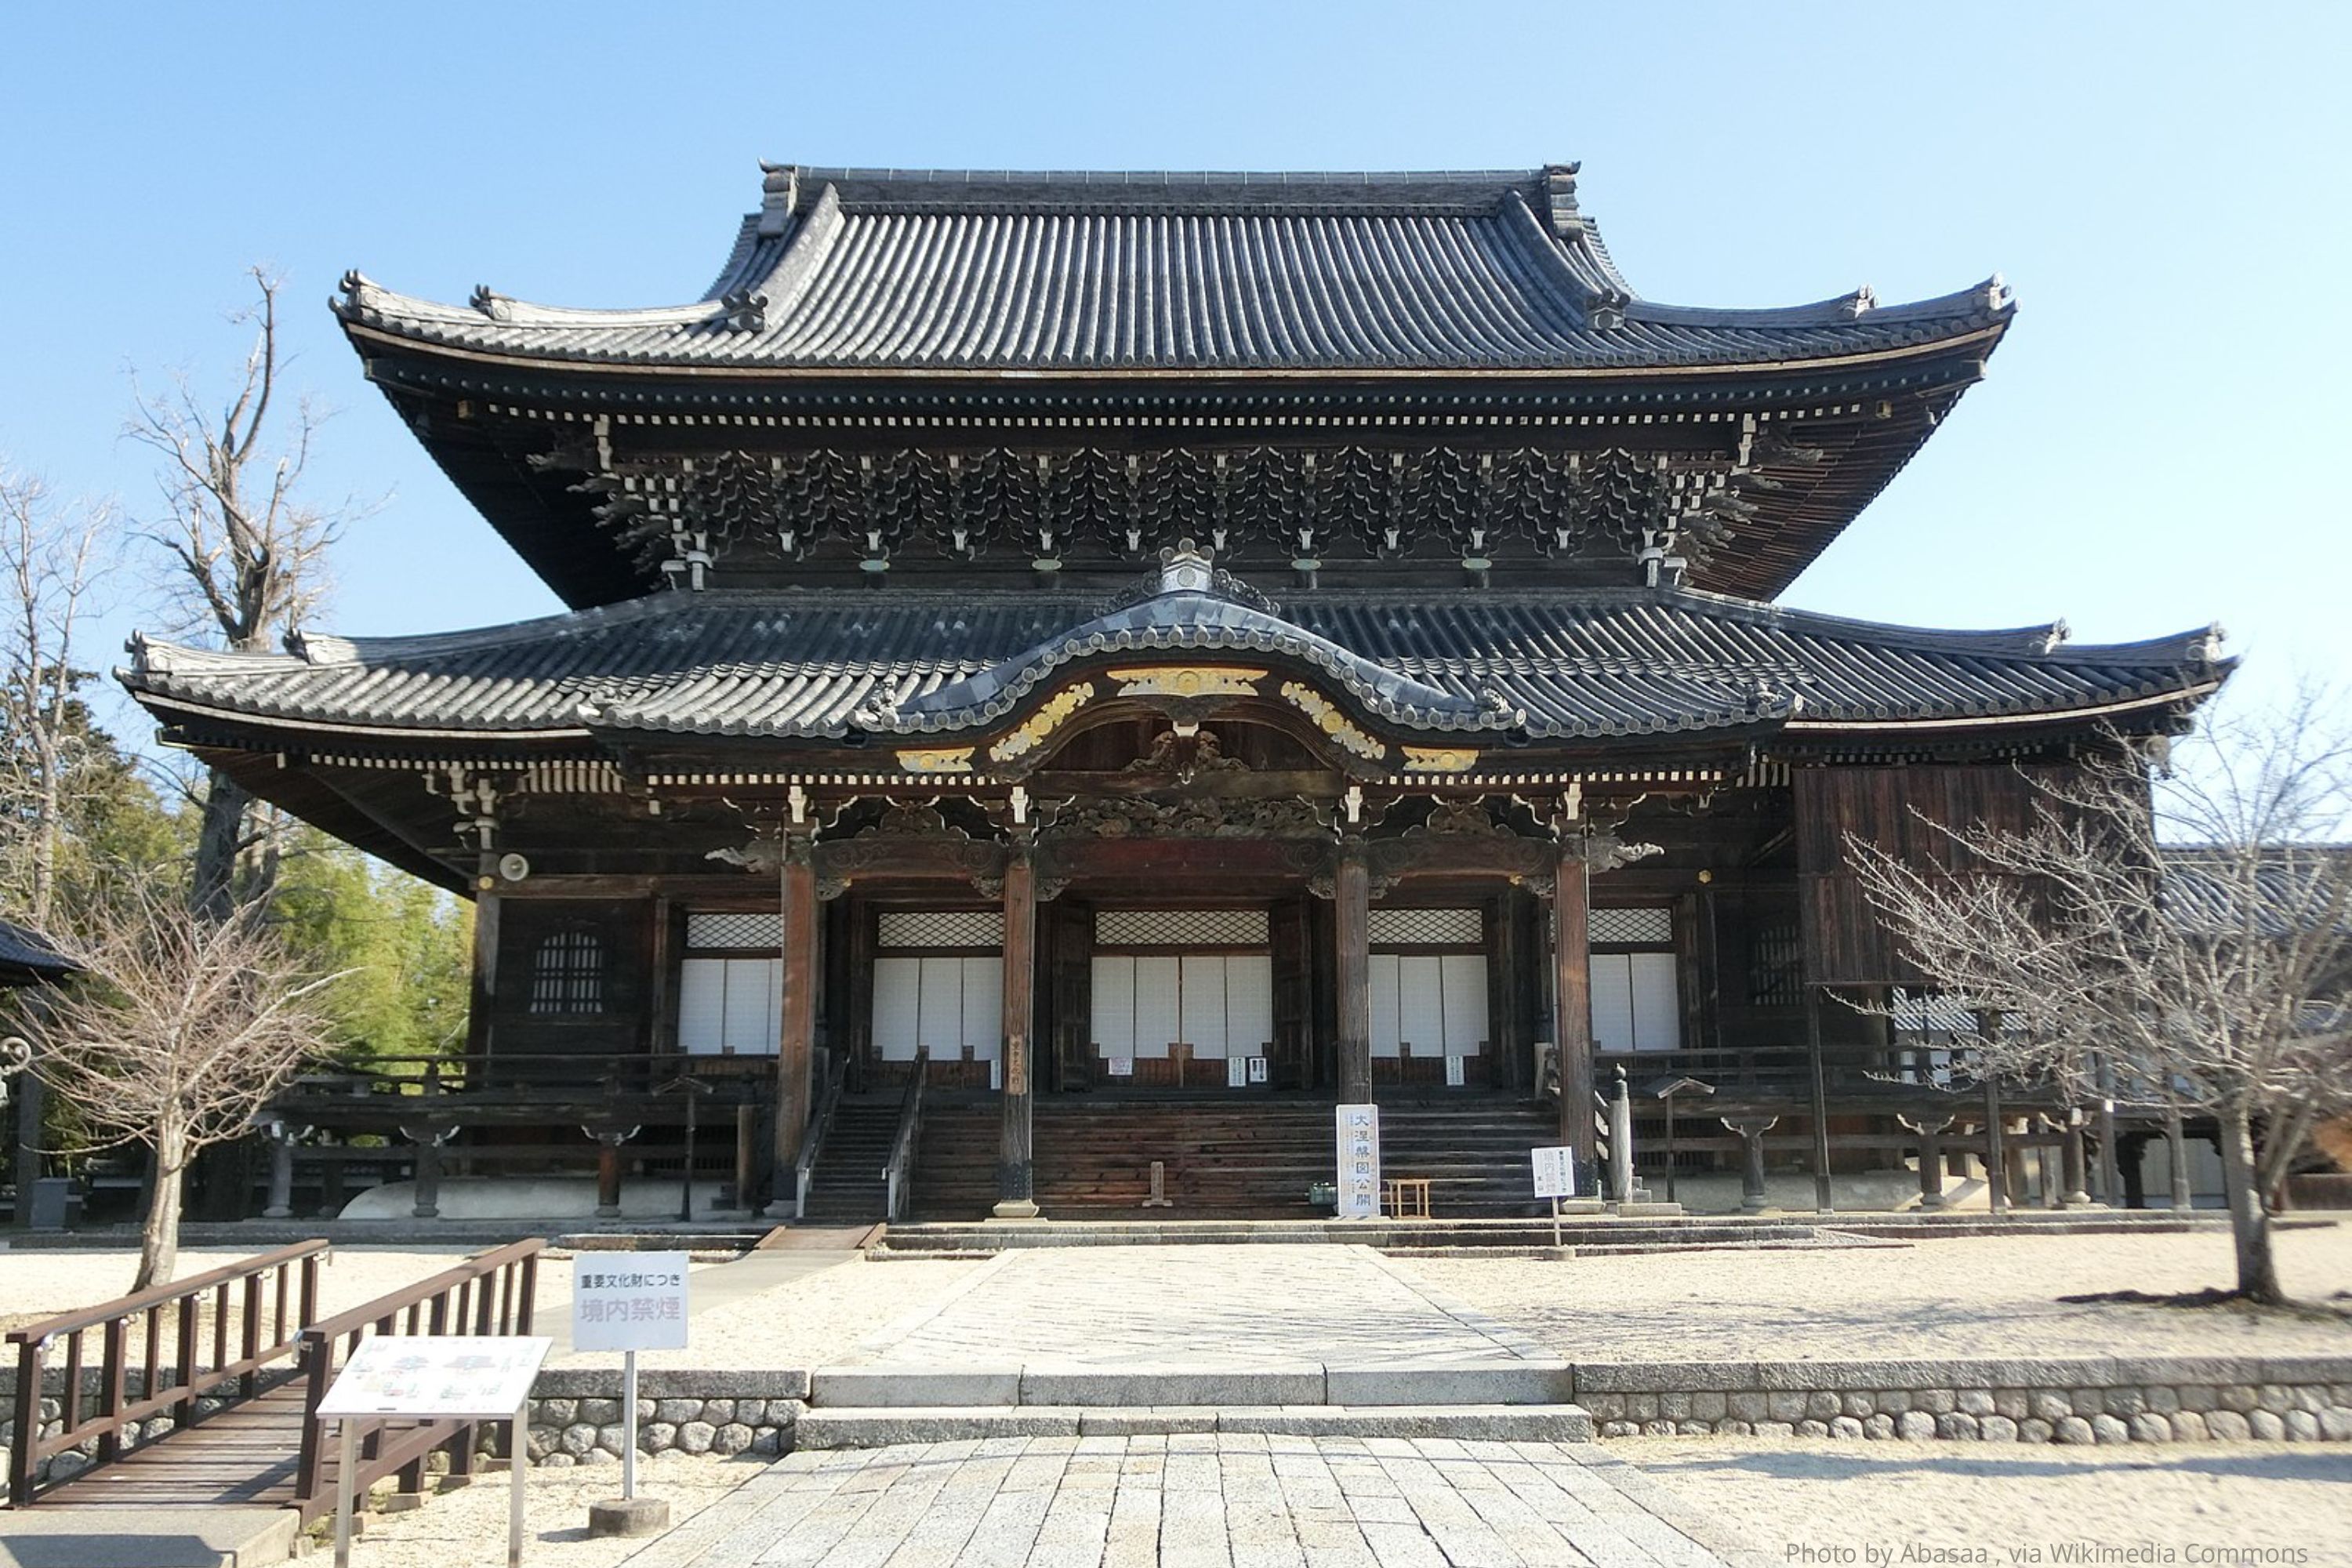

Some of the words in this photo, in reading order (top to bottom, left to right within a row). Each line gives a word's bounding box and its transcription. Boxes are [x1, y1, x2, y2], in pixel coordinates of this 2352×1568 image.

[581, 1273, 680, 1289] 重要文化財につき
[581, 1297, 680, 1323] 境内禁煙
